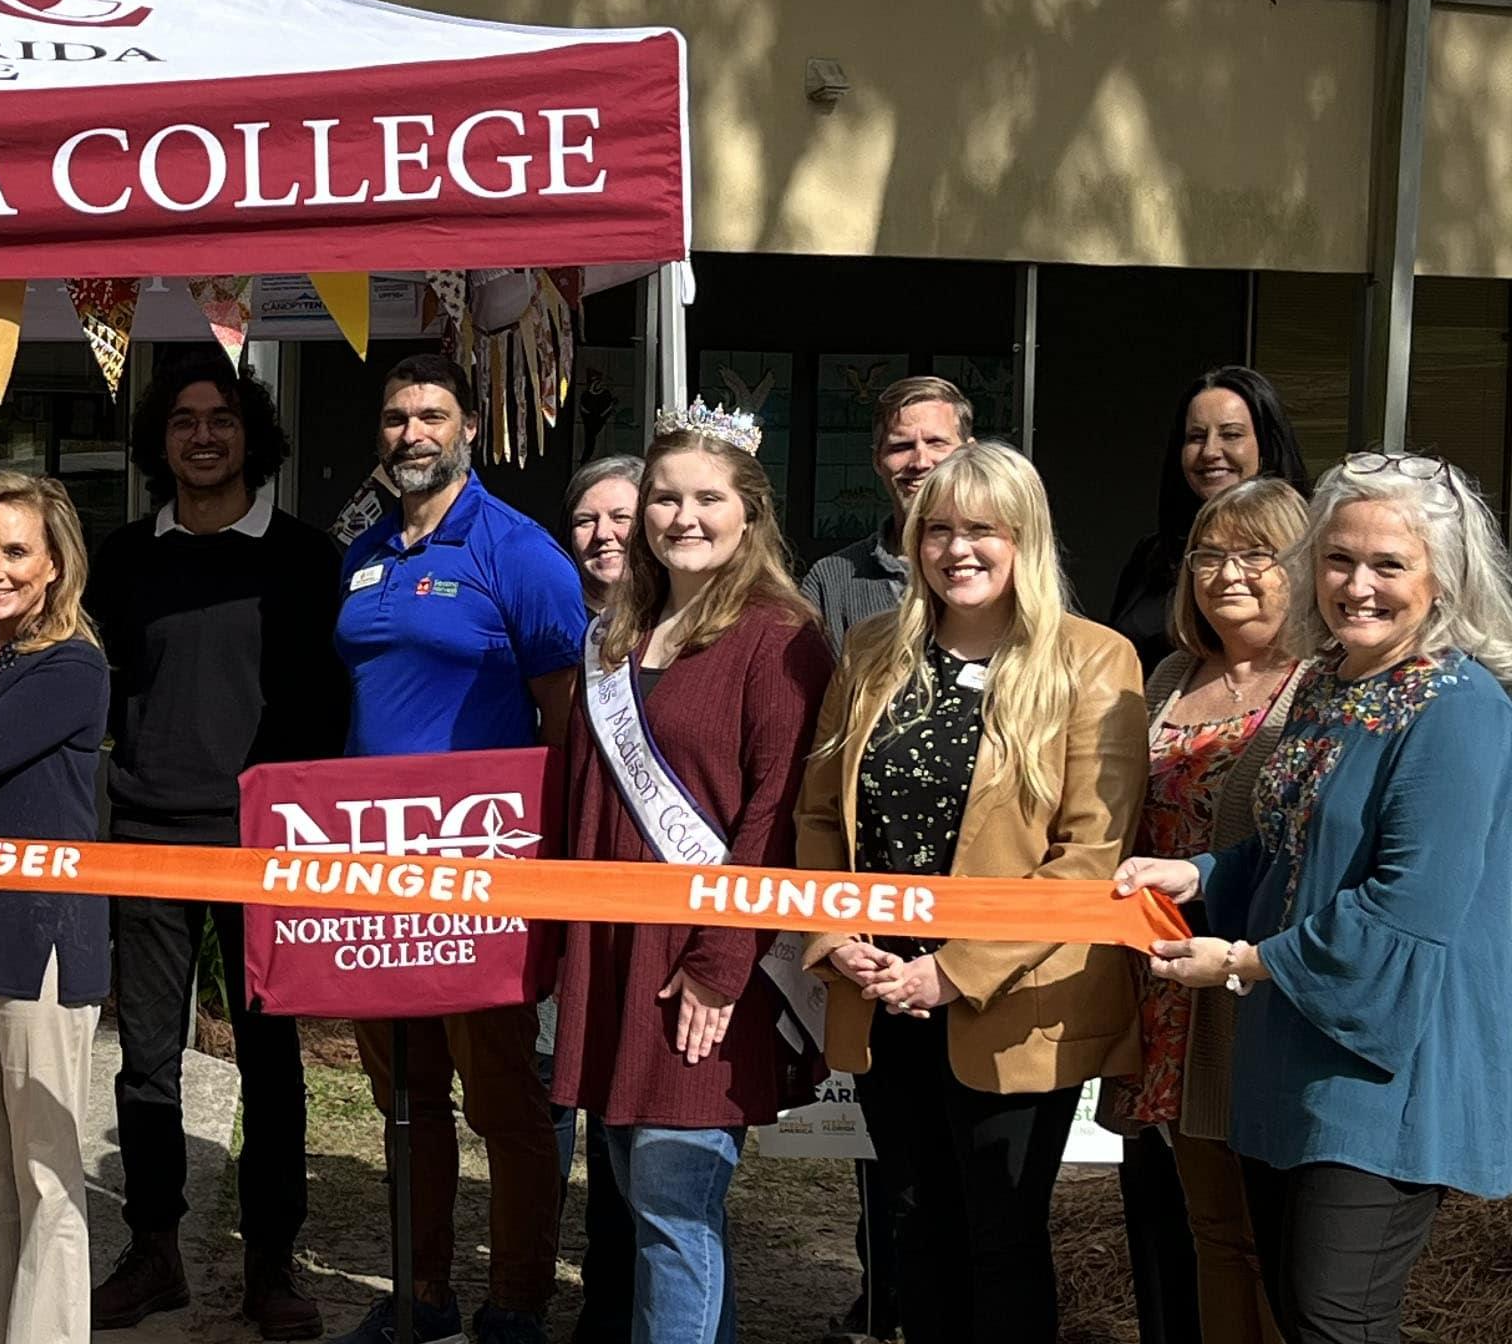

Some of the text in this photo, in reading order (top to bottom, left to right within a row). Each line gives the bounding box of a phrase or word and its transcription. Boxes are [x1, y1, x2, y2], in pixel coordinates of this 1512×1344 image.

[51, 106, 608, 216] COLLEGE
[606, 706, 659, 803] Madison
[262, 858, 493, 903] HUNGER
[689, 873, 935, 923] HUNGER
[274, 912, 528, 944] NORTH FLORIDA
[334, 938, 476, 970] COLLEGE
